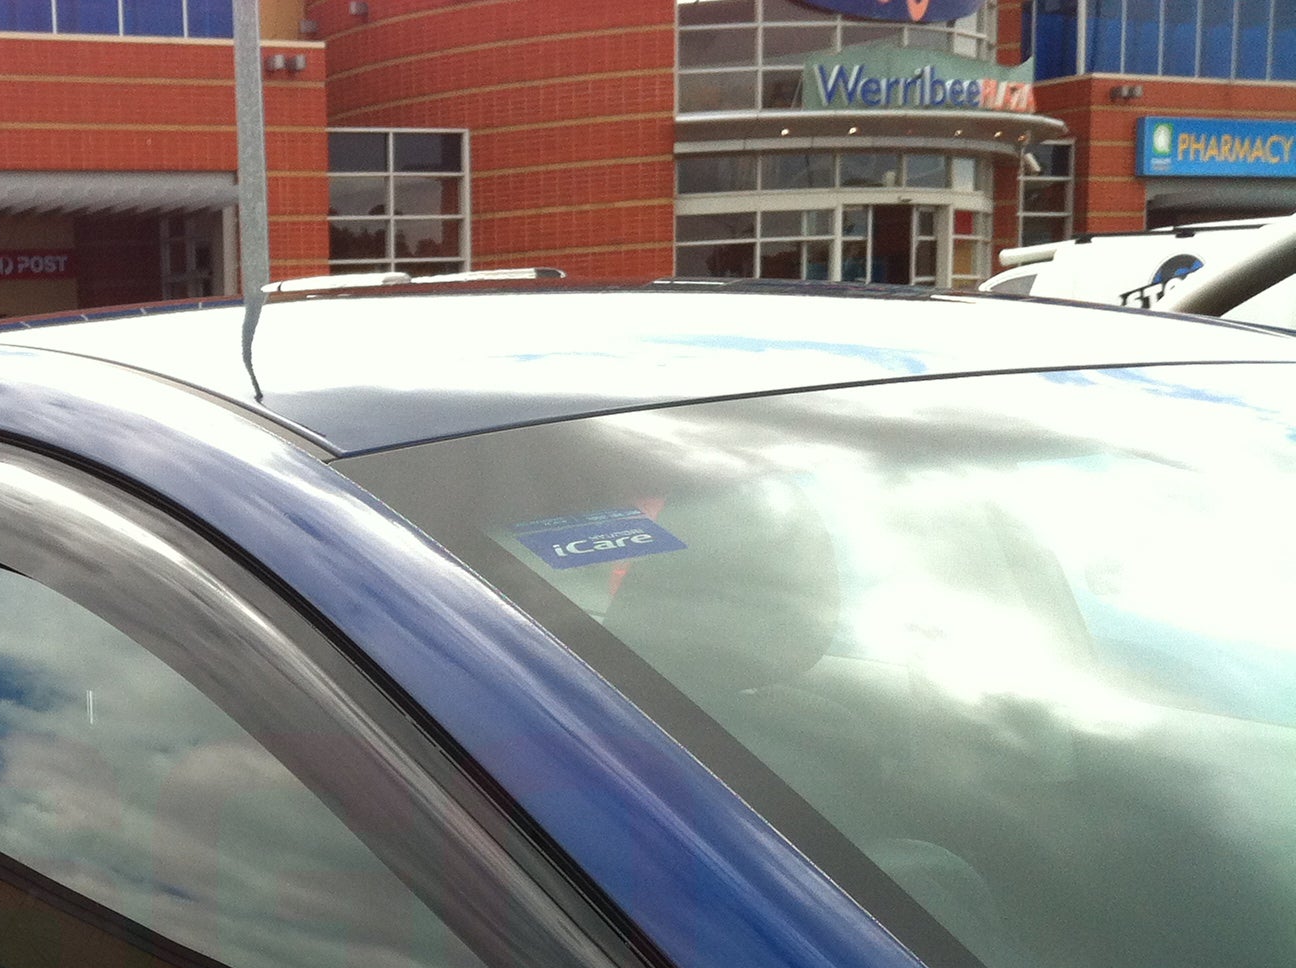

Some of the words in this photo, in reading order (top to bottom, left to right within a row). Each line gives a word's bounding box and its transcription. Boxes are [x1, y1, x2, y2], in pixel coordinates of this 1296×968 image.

[813, 64, 981, 107] Werribee
[1176, 132, 1294, 164] PHARMACY
[16, 255, 69, 274] POST
[552, 532, 655, 557] iCare
